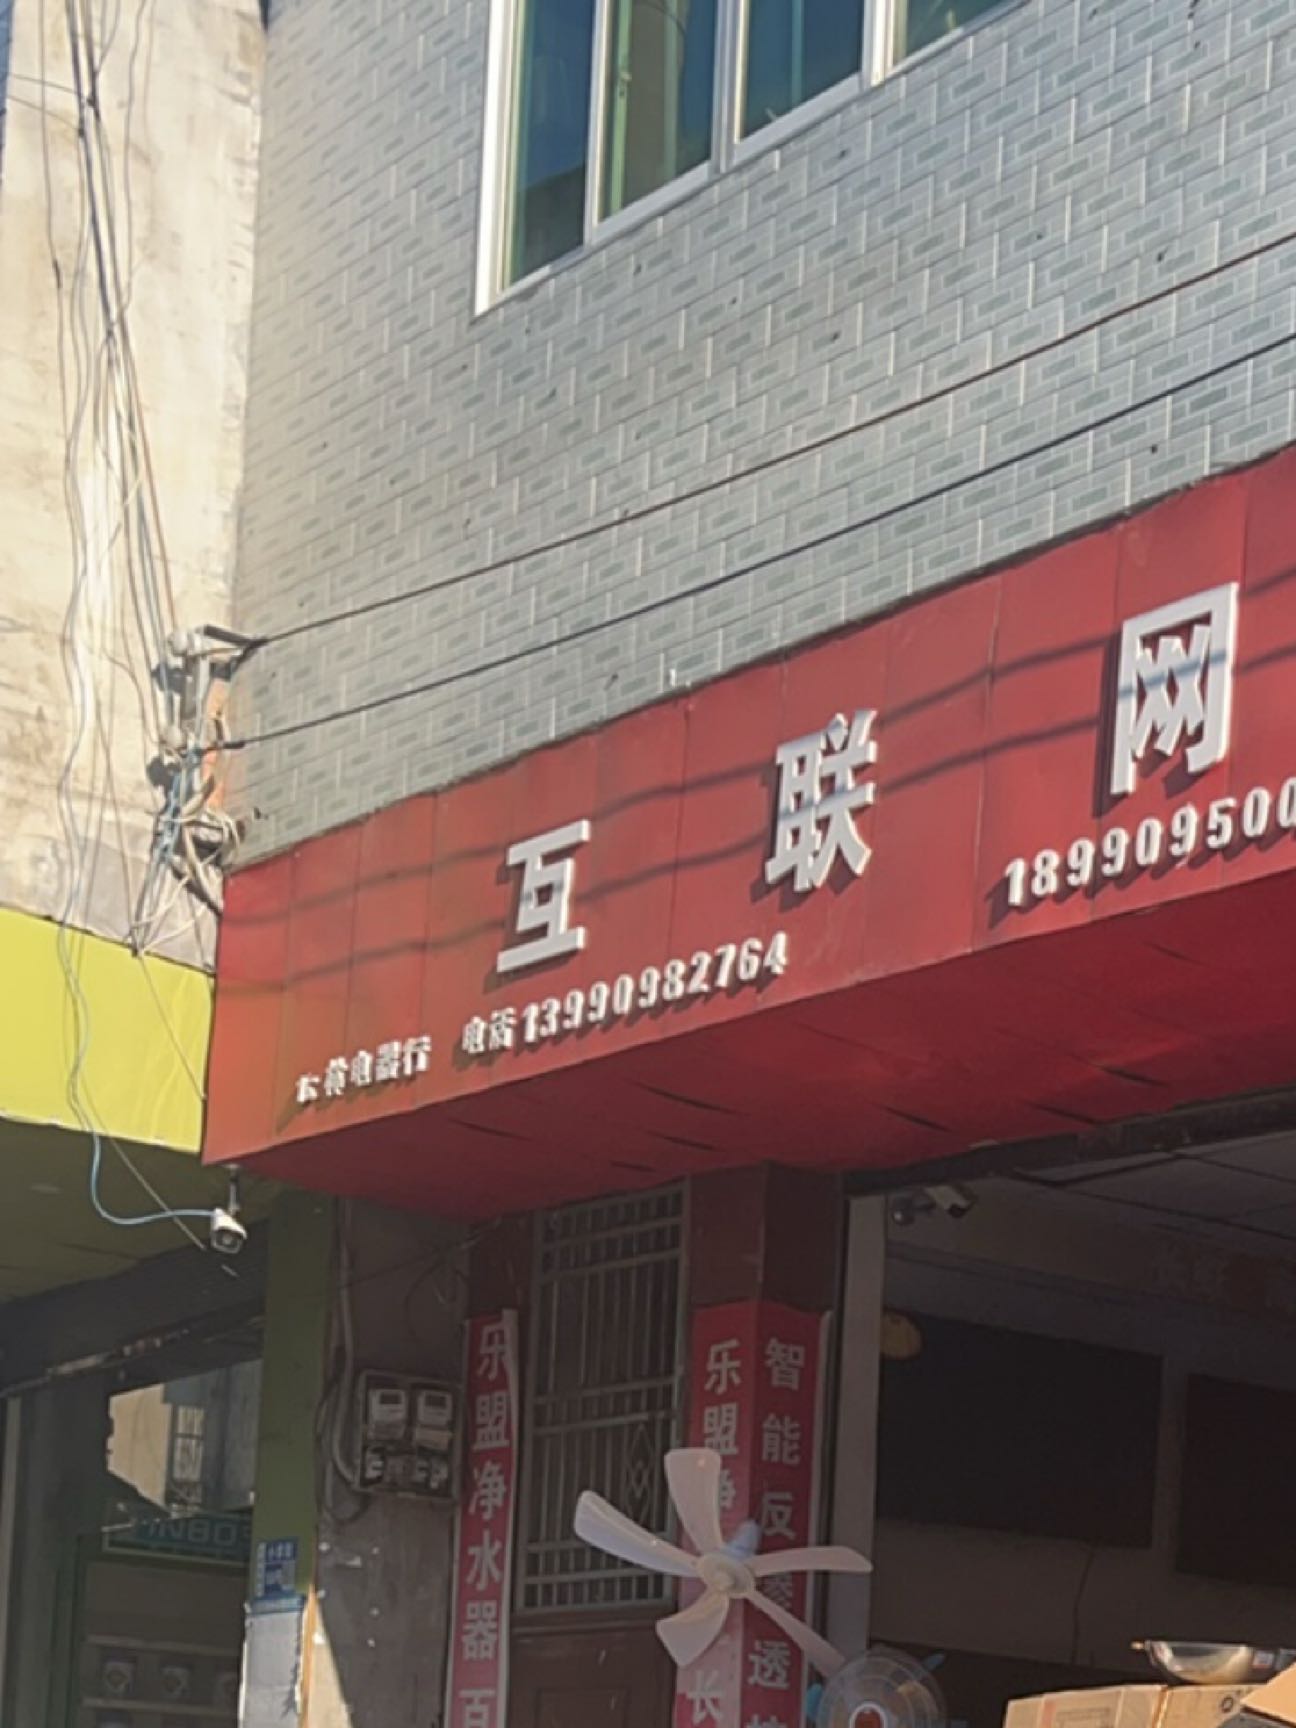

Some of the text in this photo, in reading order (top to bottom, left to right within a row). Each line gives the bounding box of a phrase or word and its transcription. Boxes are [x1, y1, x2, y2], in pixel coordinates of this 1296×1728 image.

[463, 1322, 510, 1662] 乐盟净水器
